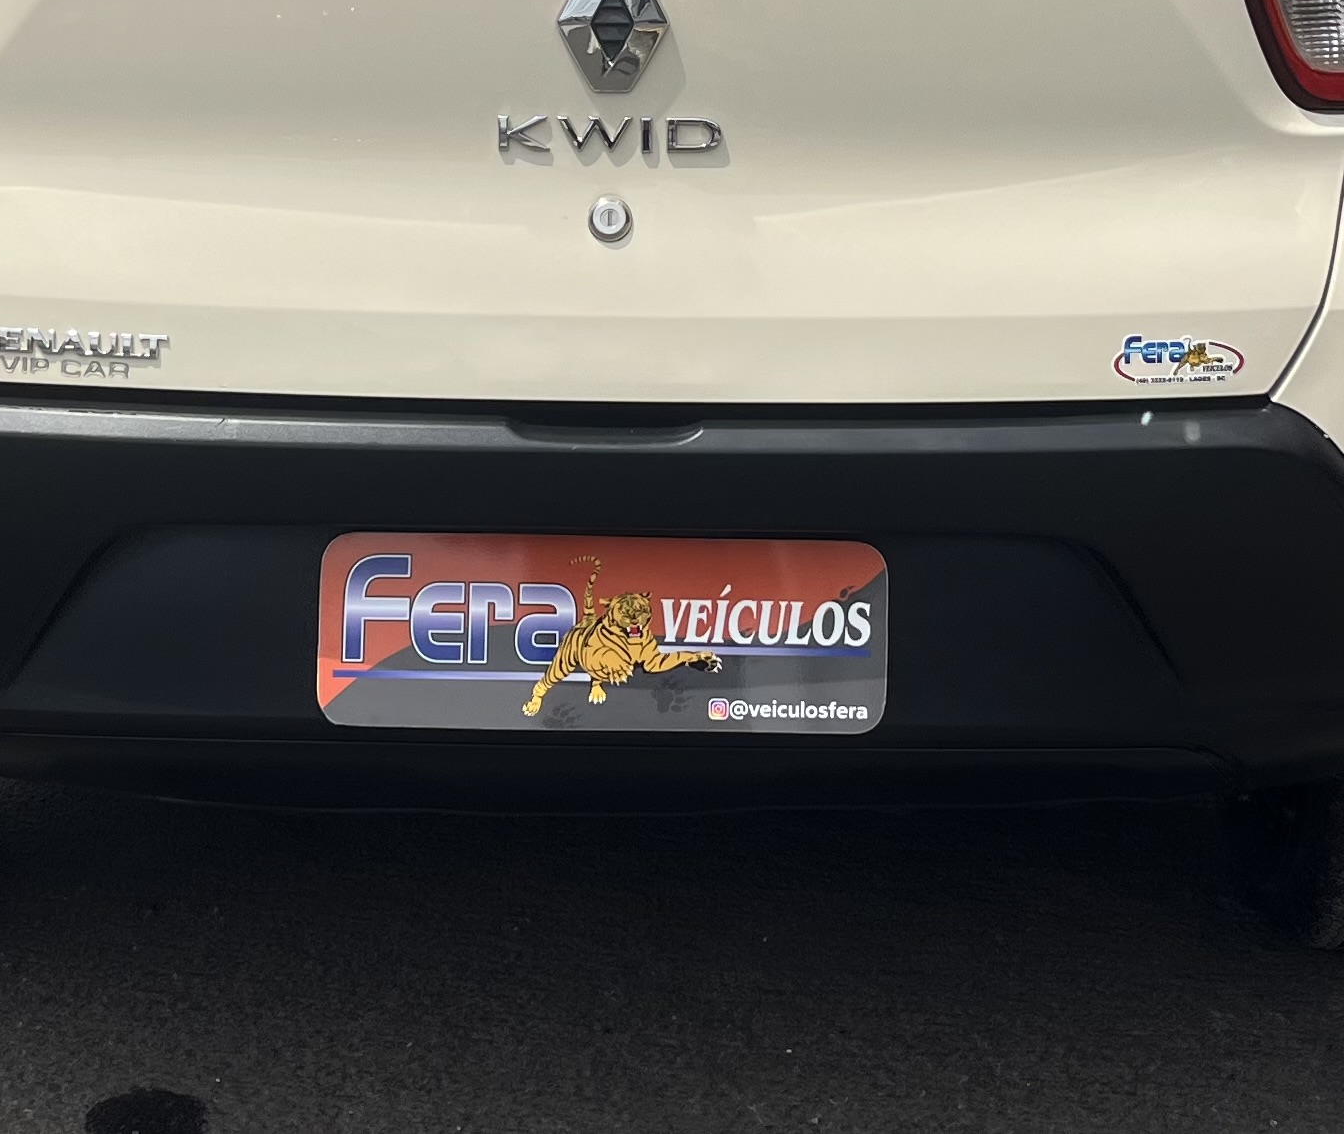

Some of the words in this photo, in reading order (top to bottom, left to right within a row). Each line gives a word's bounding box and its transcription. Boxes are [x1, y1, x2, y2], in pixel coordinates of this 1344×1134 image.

[497, 115, 722, 154] KWID
[0, 355, 50, 374] VIP
[60, 360, 130, 380] CAR
[343, 554, 577, 664] Fera
[661, 584, 872, 648] VEÍCULOS
[729, 699, 869, 720] @veiculosfera
